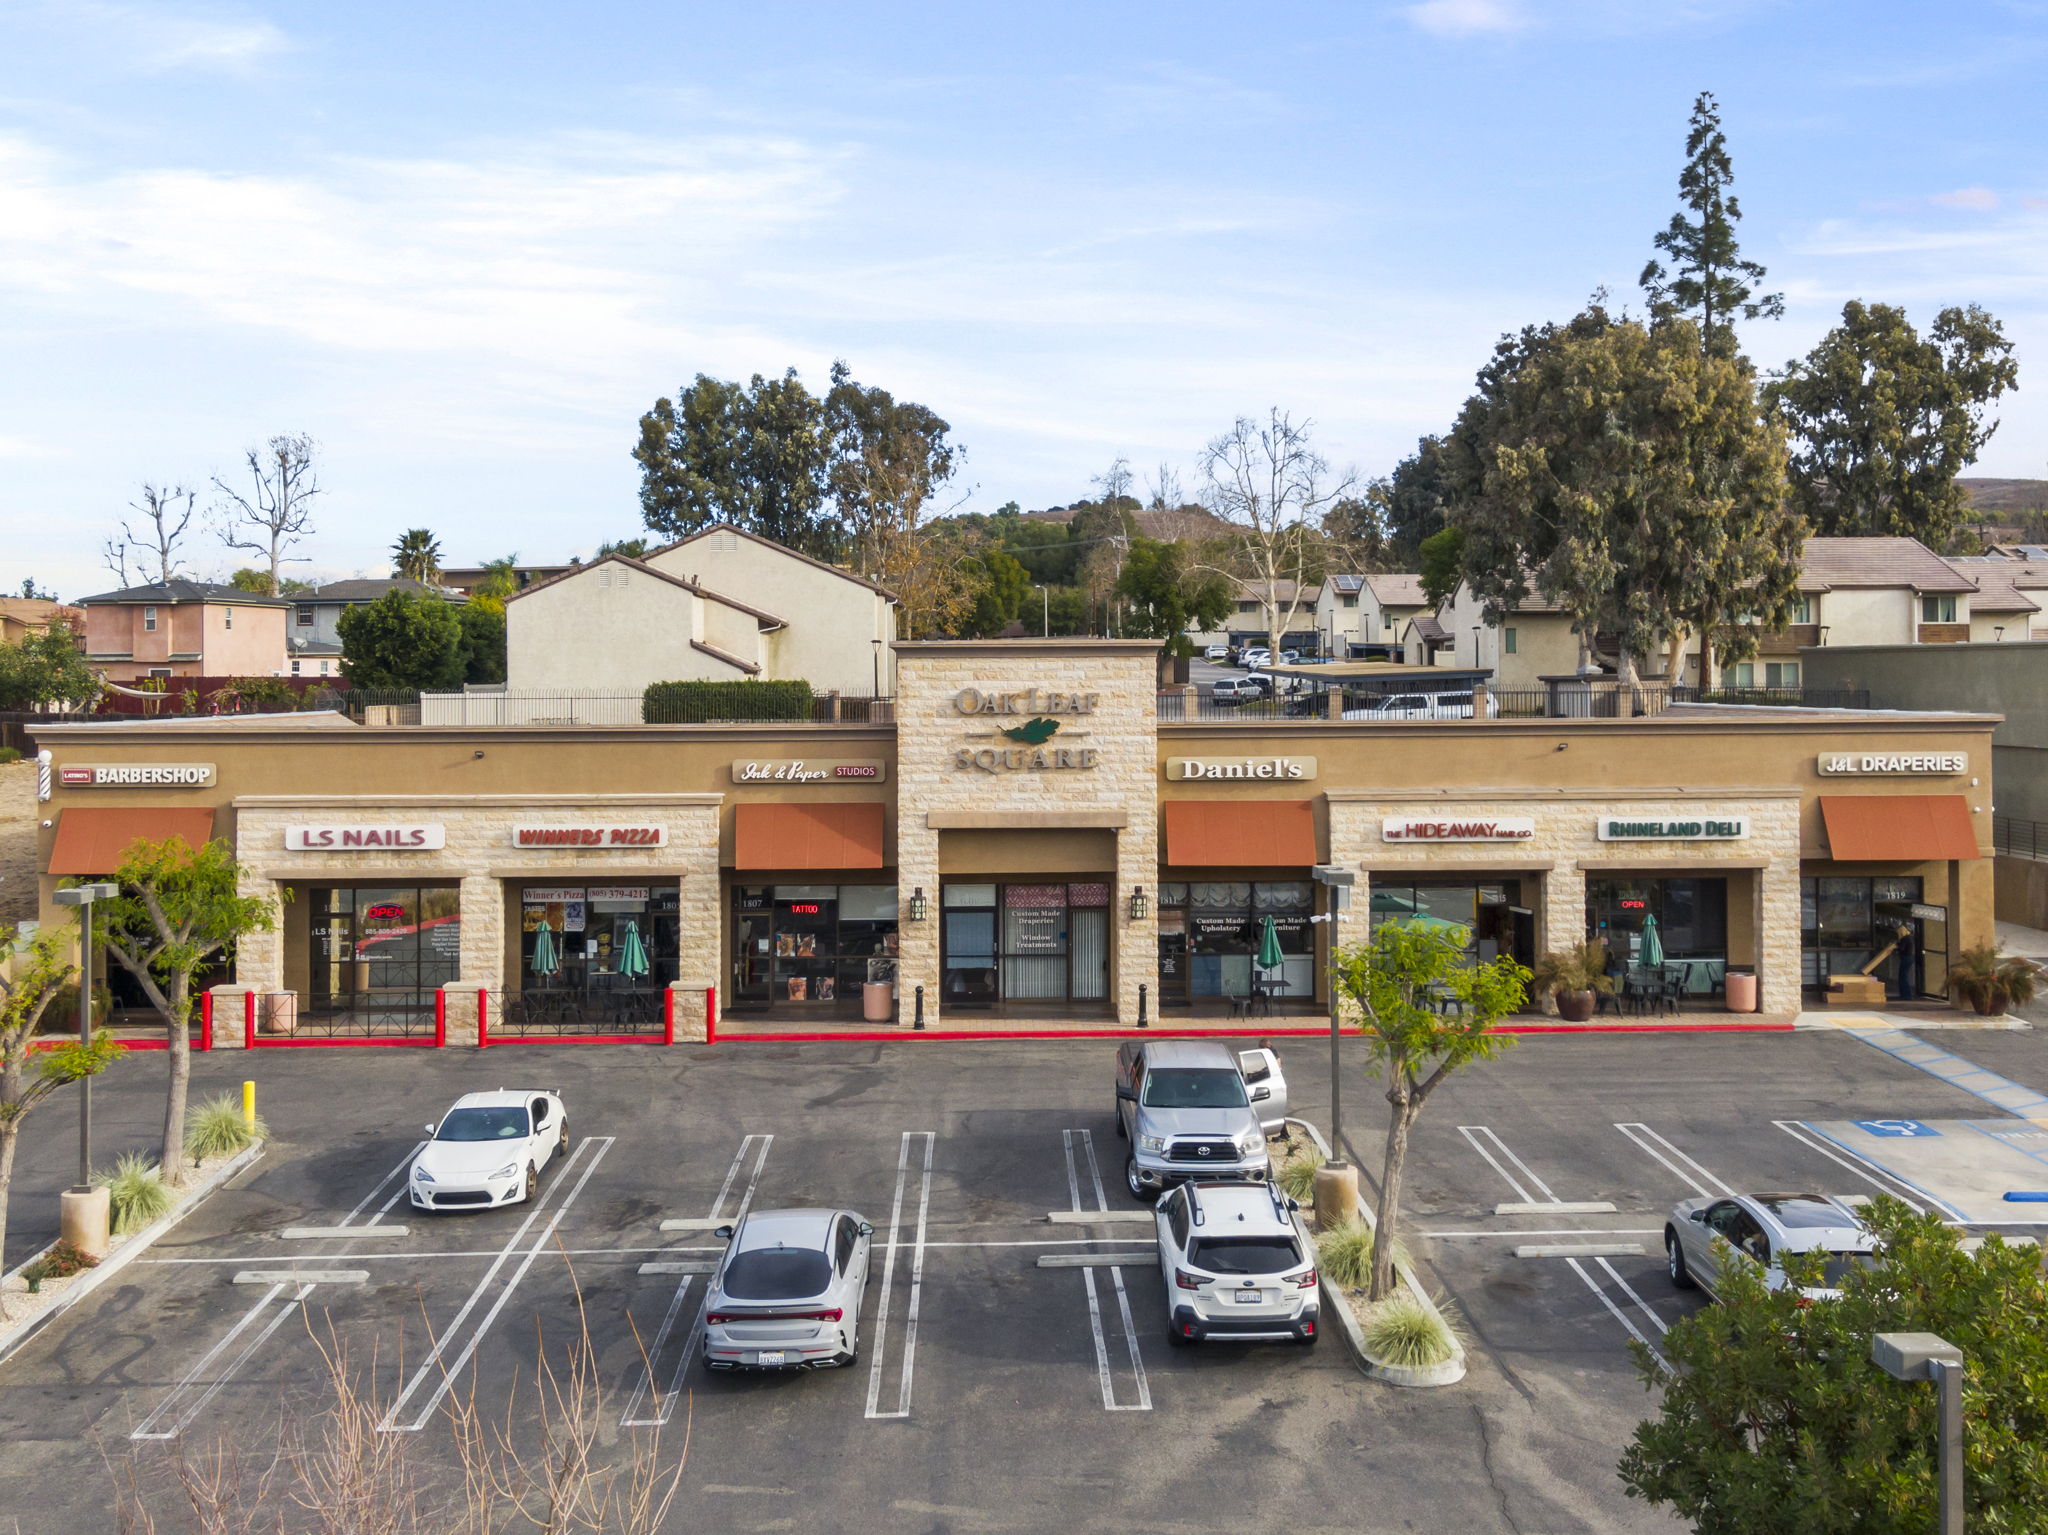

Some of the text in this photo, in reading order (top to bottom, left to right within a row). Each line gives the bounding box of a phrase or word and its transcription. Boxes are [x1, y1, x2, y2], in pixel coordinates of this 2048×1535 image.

[956, 749, 1098, 775] SQUARE
[1181, 759, 1303, 778] Daniel's
[1826, 756, 1965, 772] J&L DRAPERIES
[96, 767, 210, 783] BARBERSHOP
[741, 761, 875, 783] Ink & Paper STUDIOS
[303, 829, 426, 847] LS NAILS
[519, 829, 660, 845] WINNERS PIZZA
[1405, 823, 1498, 838] HIDEAWAY
[1496, 830, 1516, 838] HAIR
[564, 891, 585, 899] Pizza
[608, 890, 648, 899] 379-4212
[368, 905, 405, 918] OPEN
[662, 901, 681, 910] 180
[743, 900, 763, 908] 1807
[792, 905, 818, 913] TATTOO
[1621, 900, 1645, 908] OPEN
